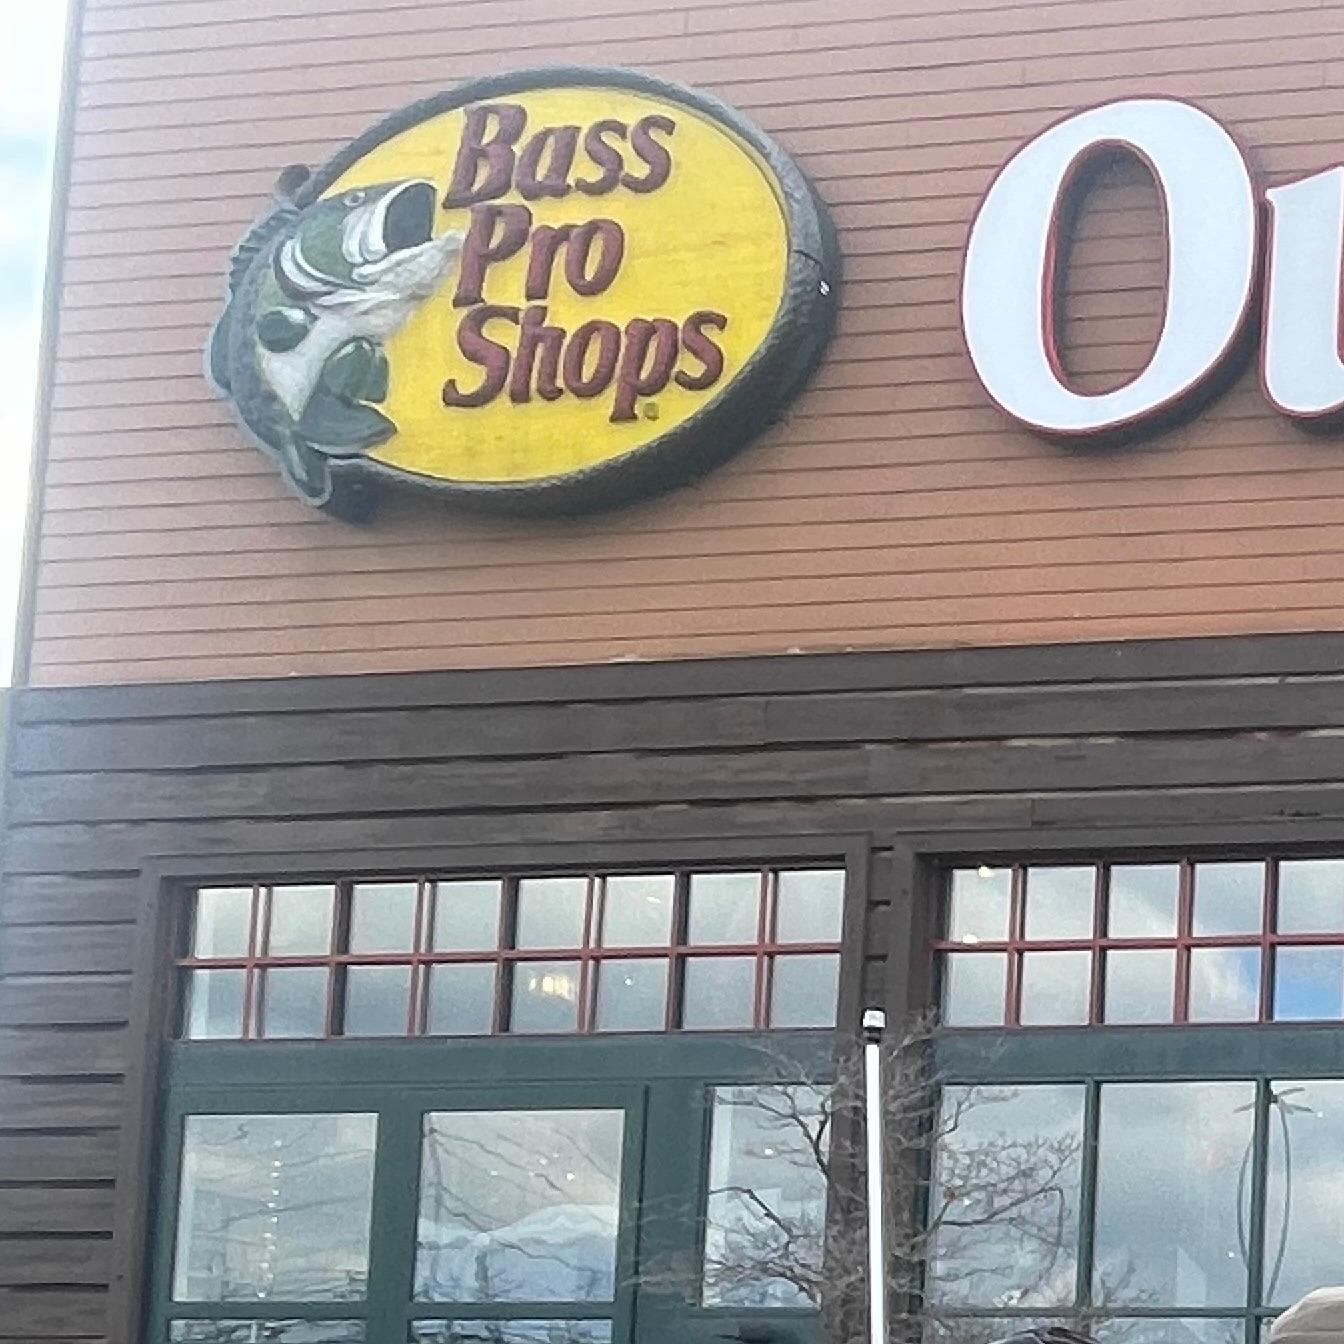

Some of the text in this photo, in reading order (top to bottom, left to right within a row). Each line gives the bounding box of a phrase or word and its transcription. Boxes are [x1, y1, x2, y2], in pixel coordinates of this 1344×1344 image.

[443, 103, 675, 209] Bass
[452, 203, 625, 307] Pro
[442, 304, 727, 423] Shops
